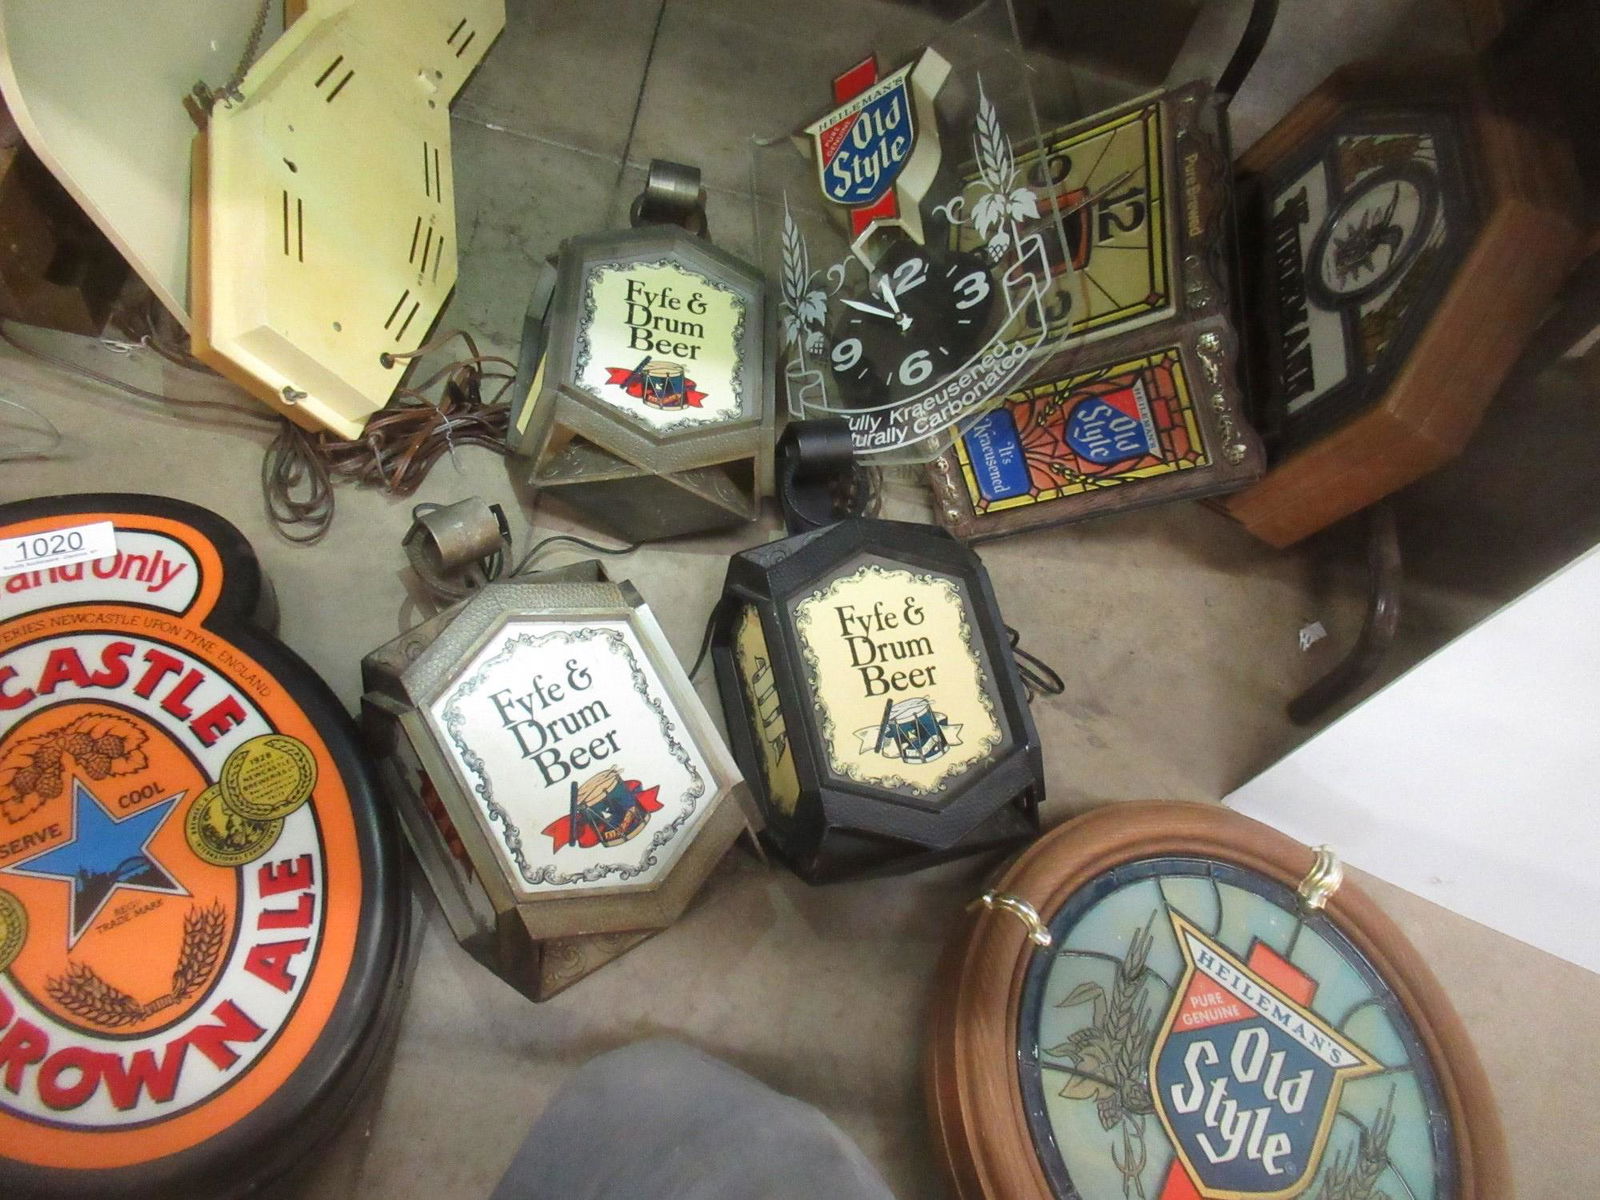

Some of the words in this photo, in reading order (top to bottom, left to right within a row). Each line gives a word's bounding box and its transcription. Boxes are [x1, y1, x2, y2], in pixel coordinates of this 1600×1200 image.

[818, 76, 902, 131] HEILEMAN'S
[852, 95, 901, 150] Old
[832, 135, 905, 198] Style
[1098, 187, 1146, 243] 12
[625, 279, 681, 311] Fyfe
[687, 292, 708, 315] &
[953, 271, 990, 310] 3
[624, 302, 705, 339] Drum
[627, 326, 702, 360] Beer
[831, 338, 863, 372] 9
[899, 350, 933, 386] 6
[851, 426, 908, 448] turally
[912, 340, 1028, 434] Carbonated
[890, 339, 1009, 426] Kraeusened
[1074, 404, 1110, 458] Style
[1108, 415, 1142, 452] Old
[16, 531, 84, 560] 1020
[92, 550, 187, 592] Only
[834, 601, 898, 641] Fyfe
[903, 596, 925, 625] &
[50, 612, 138, 628] NEWCASTLE
[144, 617, 183, 636] UPON
[182, 627, 216, 652] TYNE
[217, 651, 273, 698] ENGLAND
[844, 635, 934, 667] Drum
[0, 641, 247, 748] CASTLE
[488, 675, 565, 727] Fyfe
[565, 658, 593, 692] &
[858, 664, 937, 698] Beer
[507, 699, 611, 759] Drum
[530, 729, 622, 788] Beer
[117, 781, 165, 810] COOL
[243, 853, 315, 994] ALE
[1182, 1004, 1240, 1026] GENUINE
[1190, 991, 1224, 1008] PURE
[1196, 949, 1342, 1064] HEILEMAN'S
[1230, 1027, 1315, 1115] Old
[1170, 1040, 1292, 1176] Style
